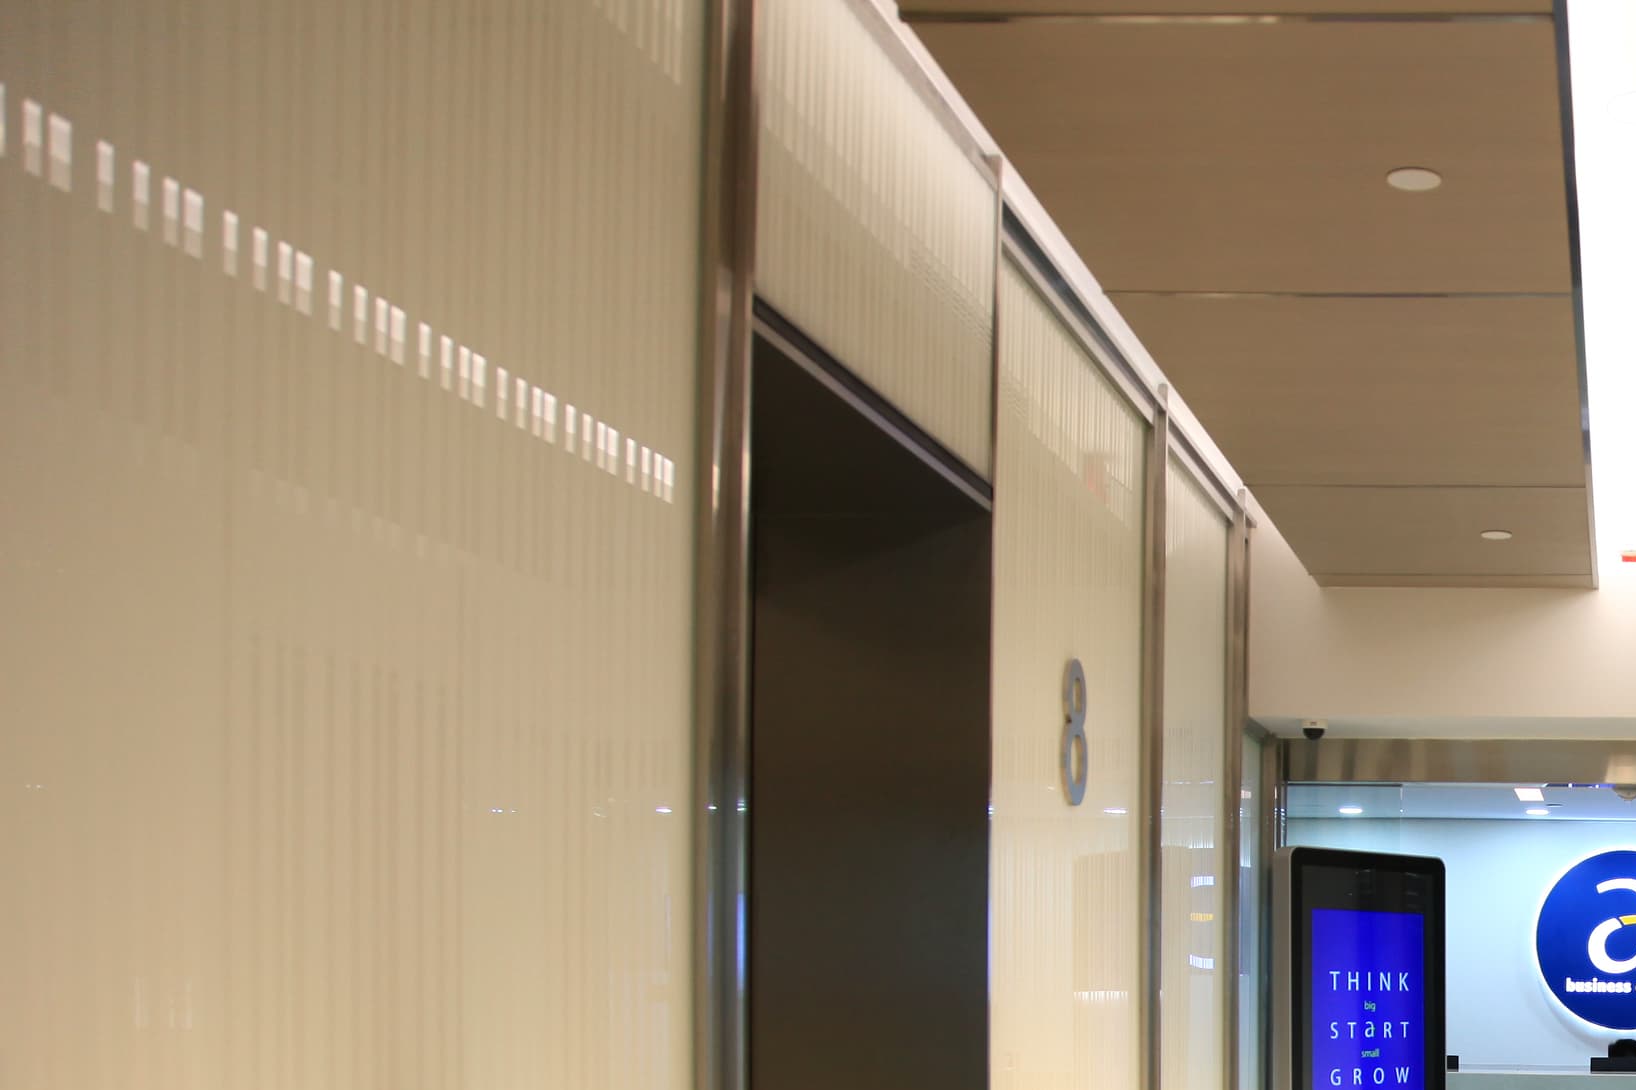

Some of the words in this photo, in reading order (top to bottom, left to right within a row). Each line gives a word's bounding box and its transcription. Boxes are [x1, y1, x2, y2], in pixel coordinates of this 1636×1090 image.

[1061, 658, 1088, 806] 8
[1329, 971, 1409, 992] THINK
[1565, 977, 1632, 993] business
[1363, 1000, 1376, 1012] big
[1361, 1048, 1380, 1058] small
[1330, 1066, 1410, 1086] GROW
